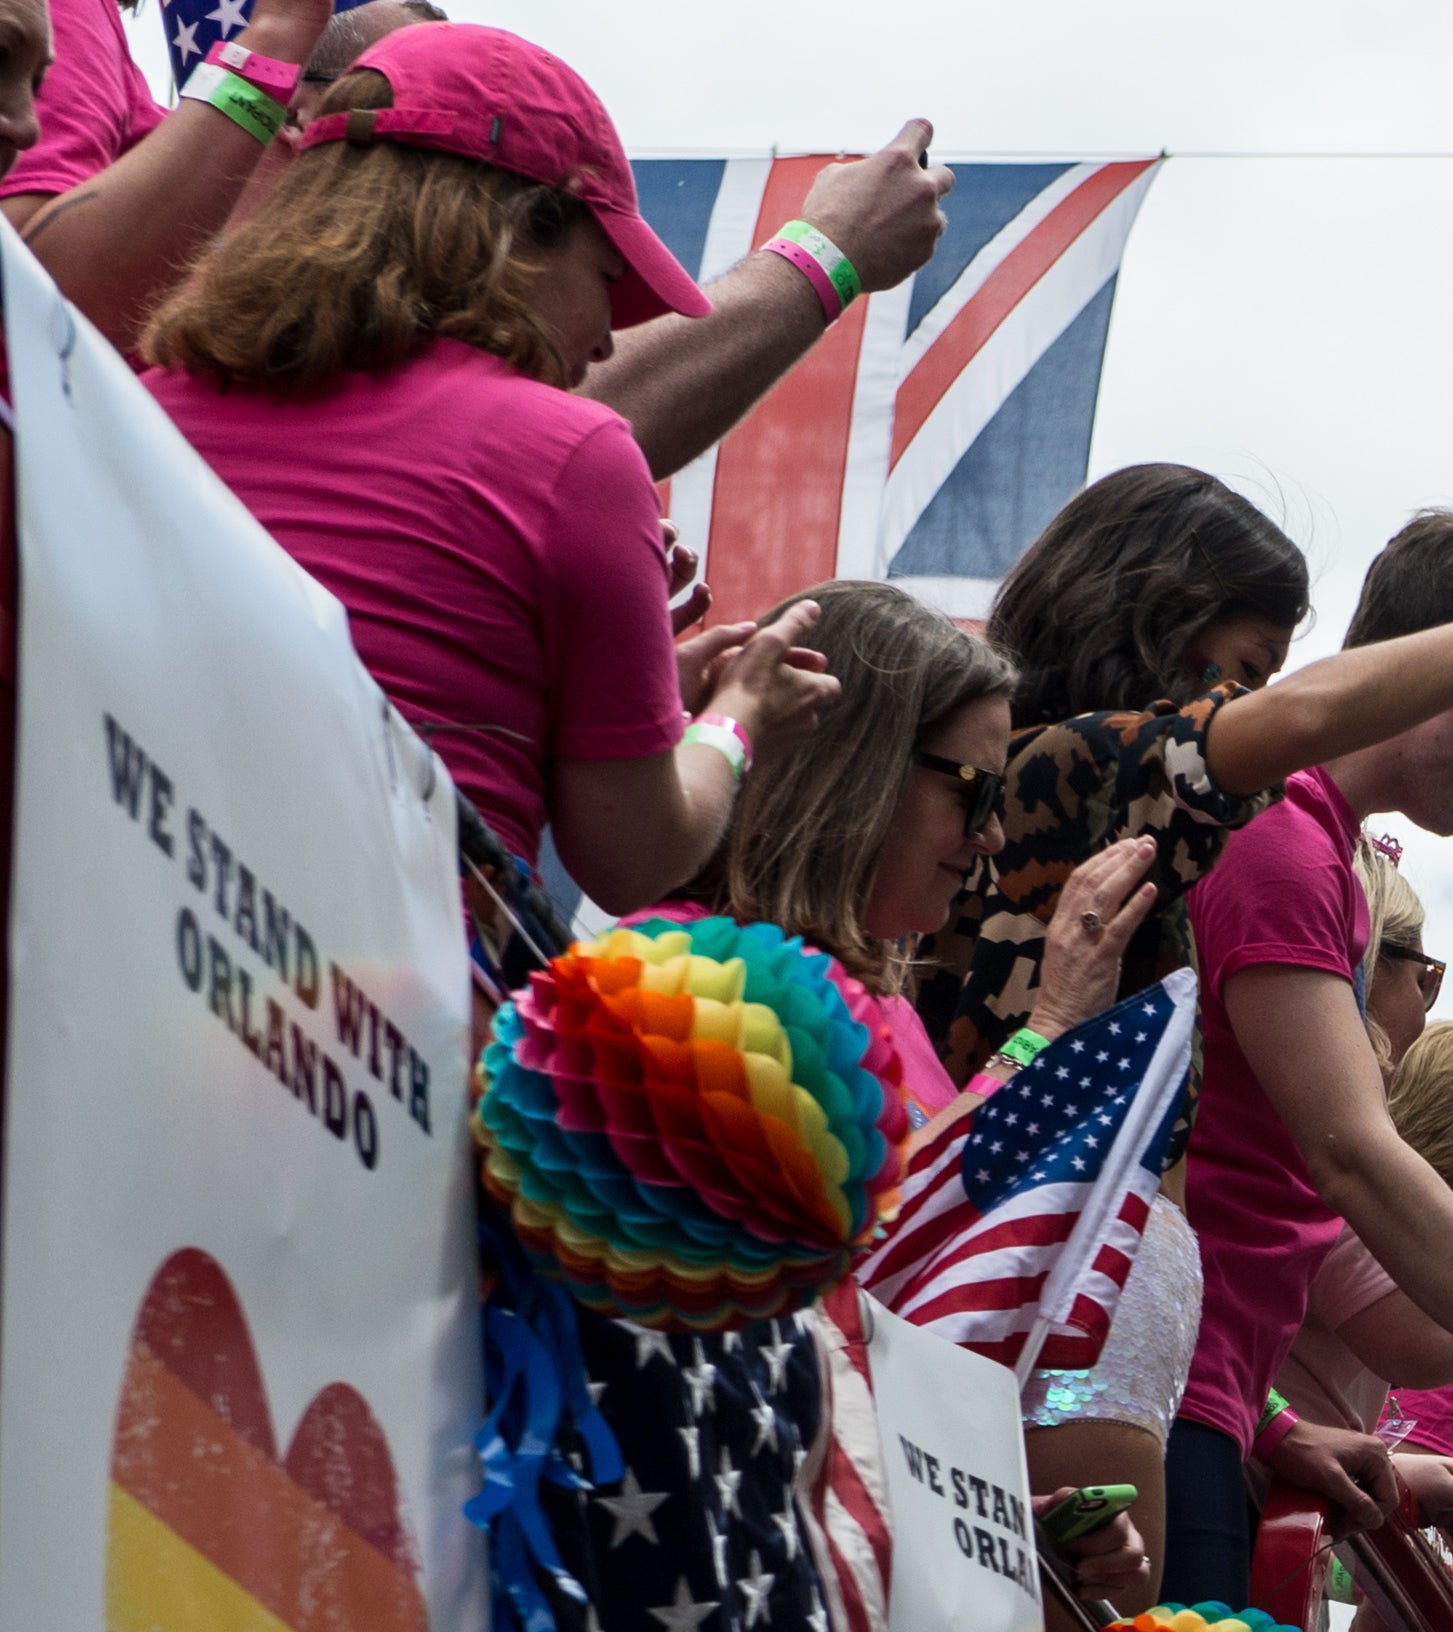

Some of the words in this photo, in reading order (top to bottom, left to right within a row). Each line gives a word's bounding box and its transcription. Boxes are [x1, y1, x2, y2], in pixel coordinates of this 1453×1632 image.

[104, 712, 174, 858] WE
[185, 806, 321, 1010] STAND
[330, 958, 433, 1137] WITH
[175, 905, 380, 1172] ORLANDO
[898, 1432, 946, 1498] WE
[951, 1467, 1027, 1541] STAN
[953, 1517, 1037, 1601] ORLA
